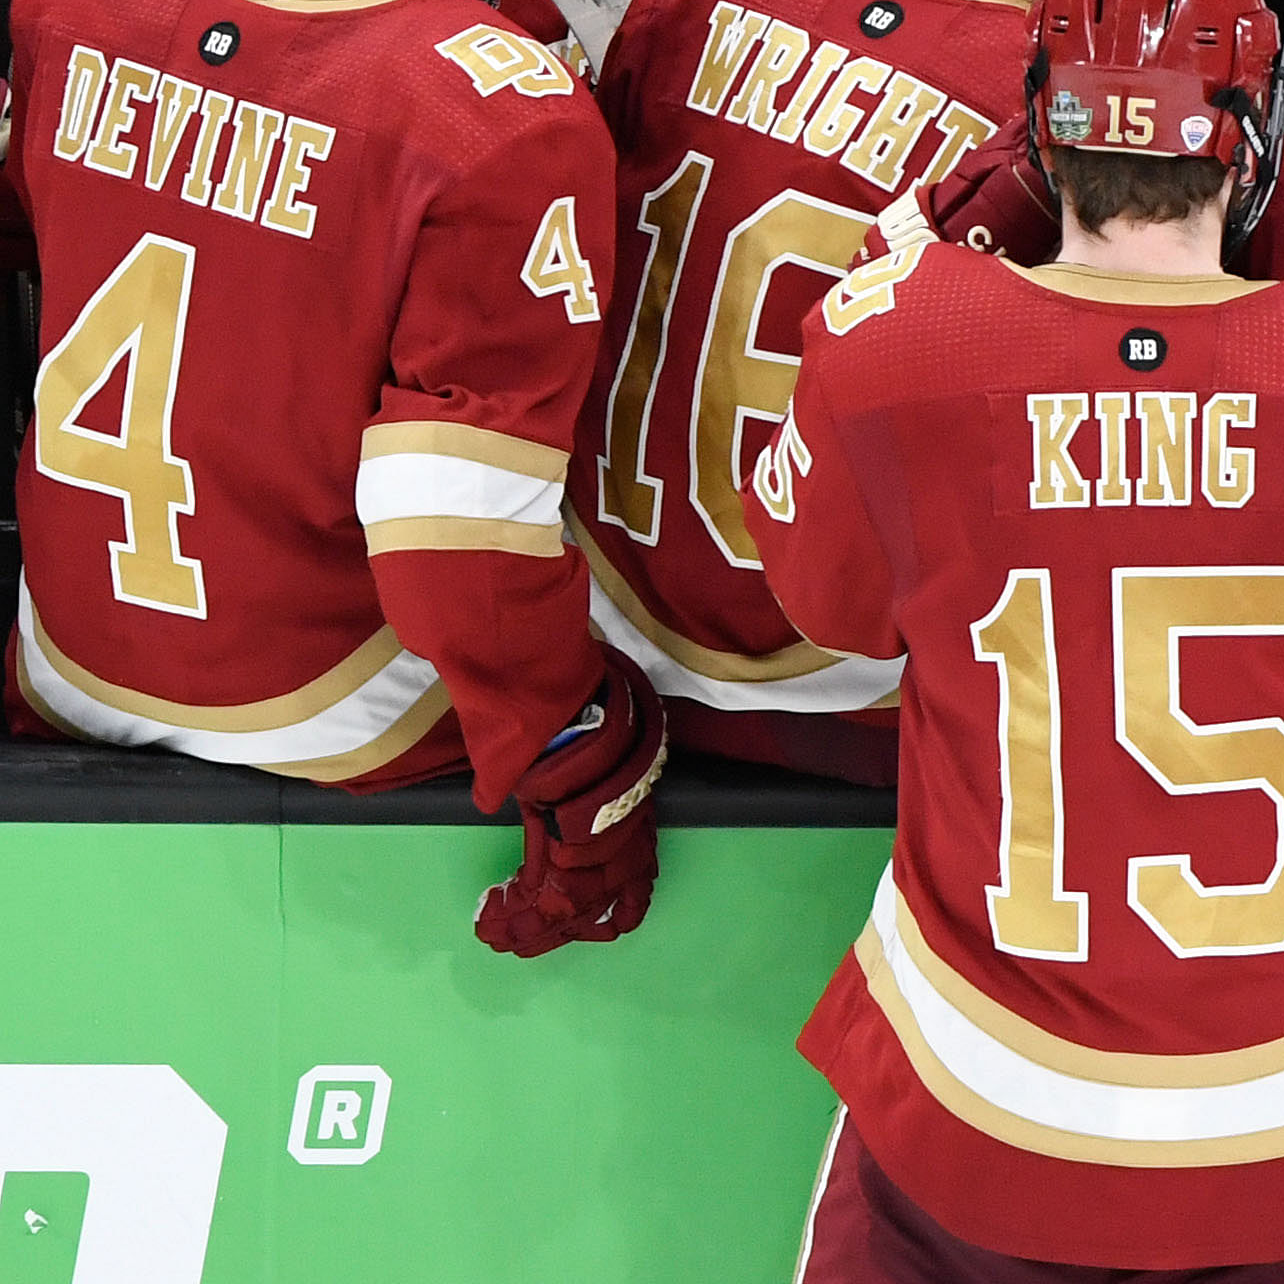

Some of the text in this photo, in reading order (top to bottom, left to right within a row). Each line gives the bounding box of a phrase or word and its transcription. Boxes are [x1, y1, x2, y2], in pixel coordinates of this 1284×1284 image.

[204, 31, 232, 57] RB
[864, 6, 897, 29] RB
[53, 44, 337, 239] DEVINE
[685, 0, 1000, 193] WRIGHT
[1105, 95, 1156, 146] 15
[520, 197, 600, 324] 4
[596, 150, 882, 572] 16
[1130, 337, 1158, 363] RB
[34, 233, 207, 619] 4
[752, 399, 813, 524] 5
[1026, 390, 1257, 510] KING
